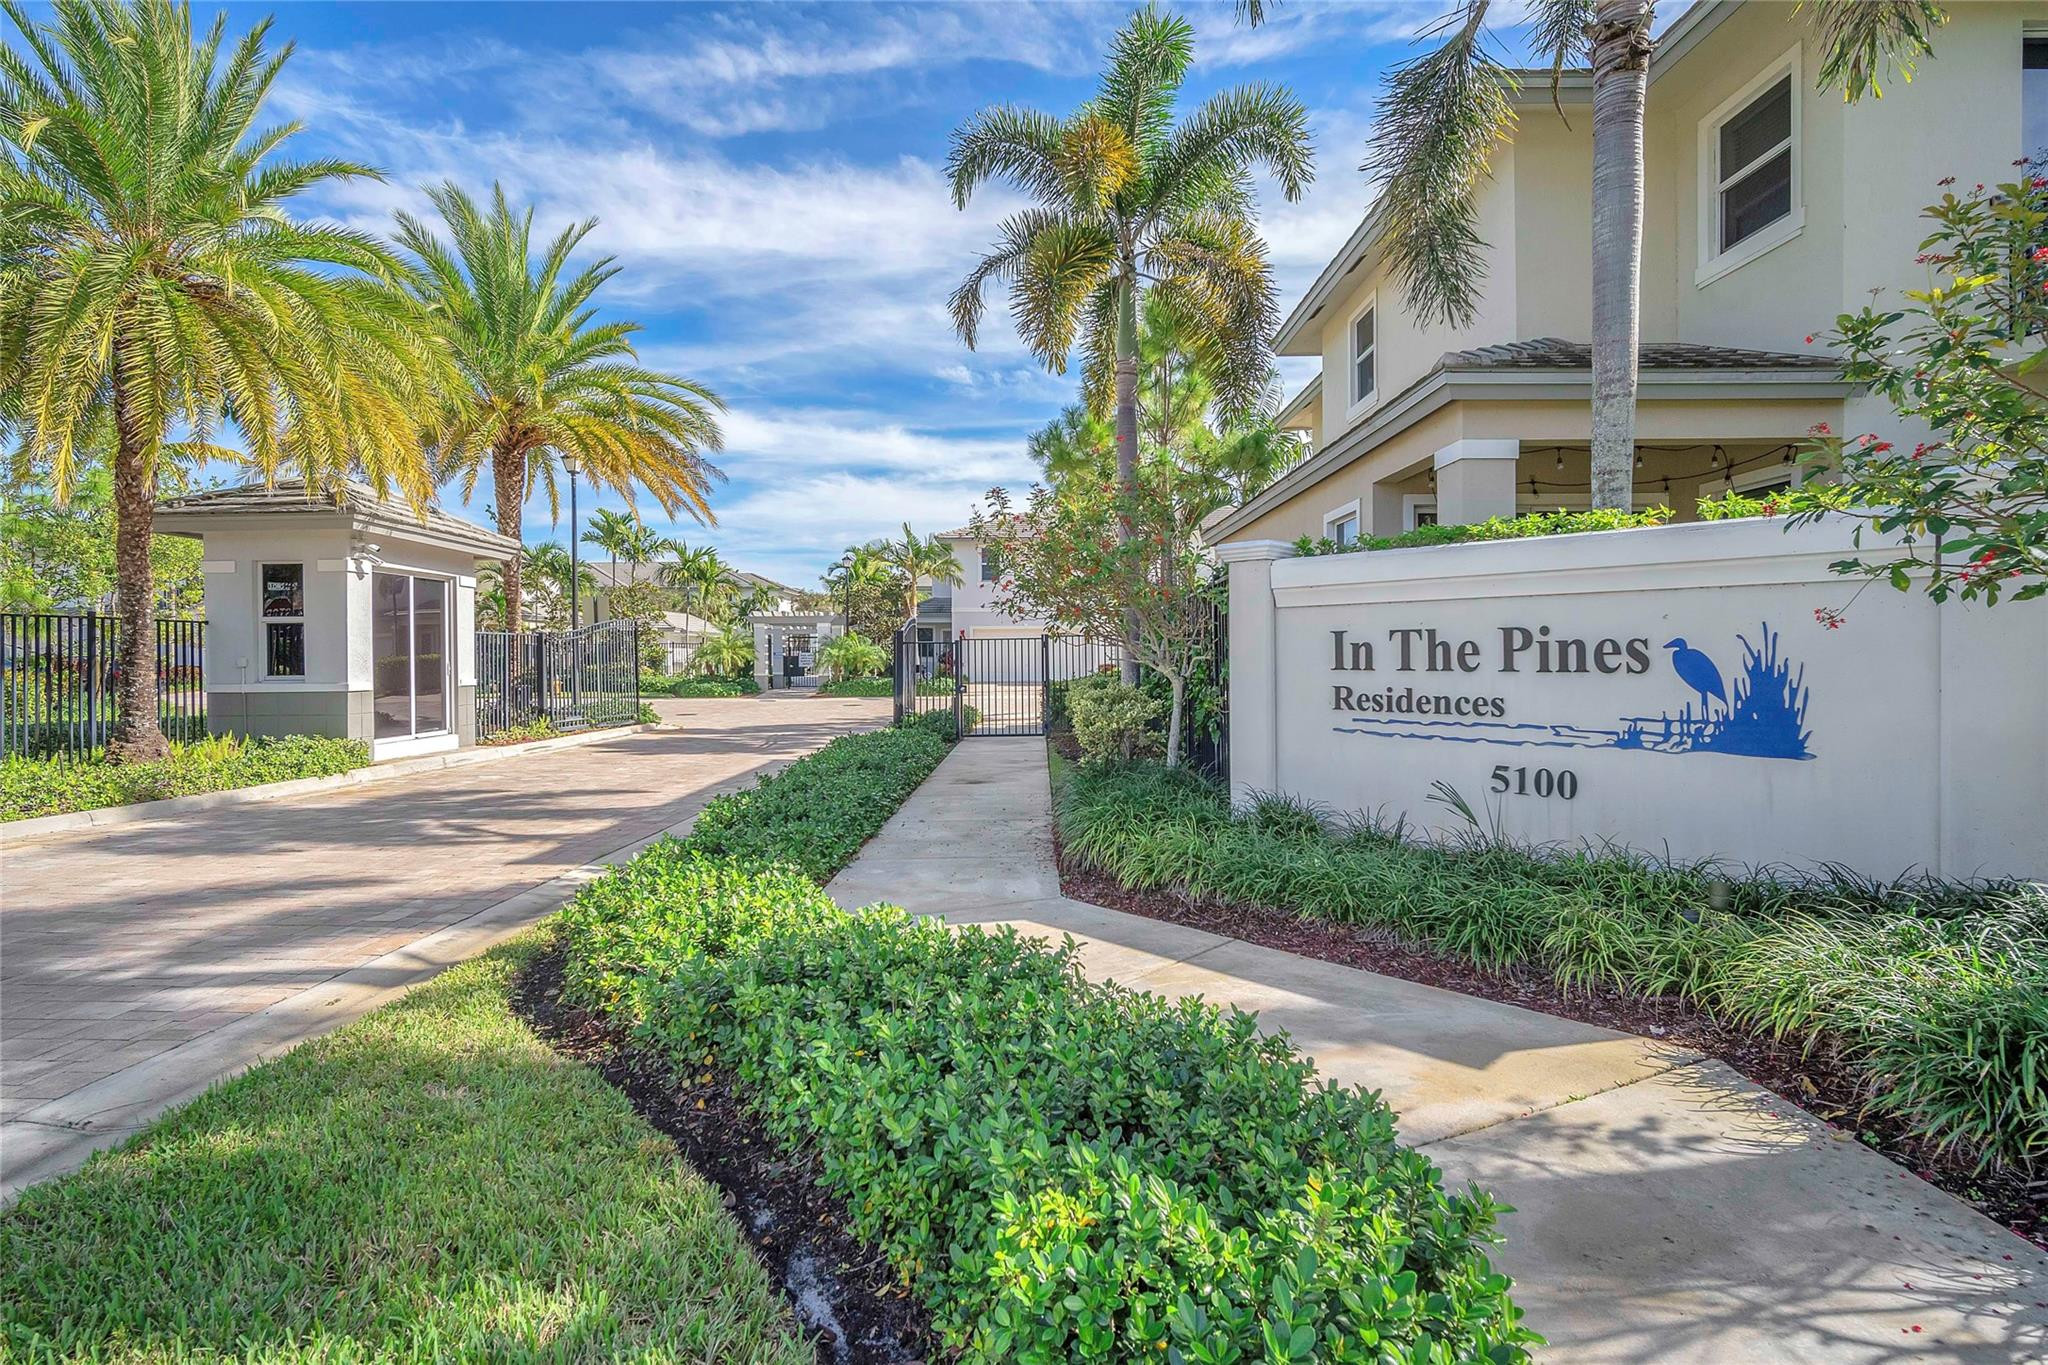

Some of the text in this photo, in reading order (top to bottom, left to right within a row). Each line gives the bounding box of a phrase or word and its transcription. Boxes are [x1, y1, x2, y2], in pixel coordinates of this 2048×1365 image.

[1330, 625, 1651, 675] In The Pines
[1332, 685, 1506, 718] Residences
[1490, 764, 1578, 800] 5100
